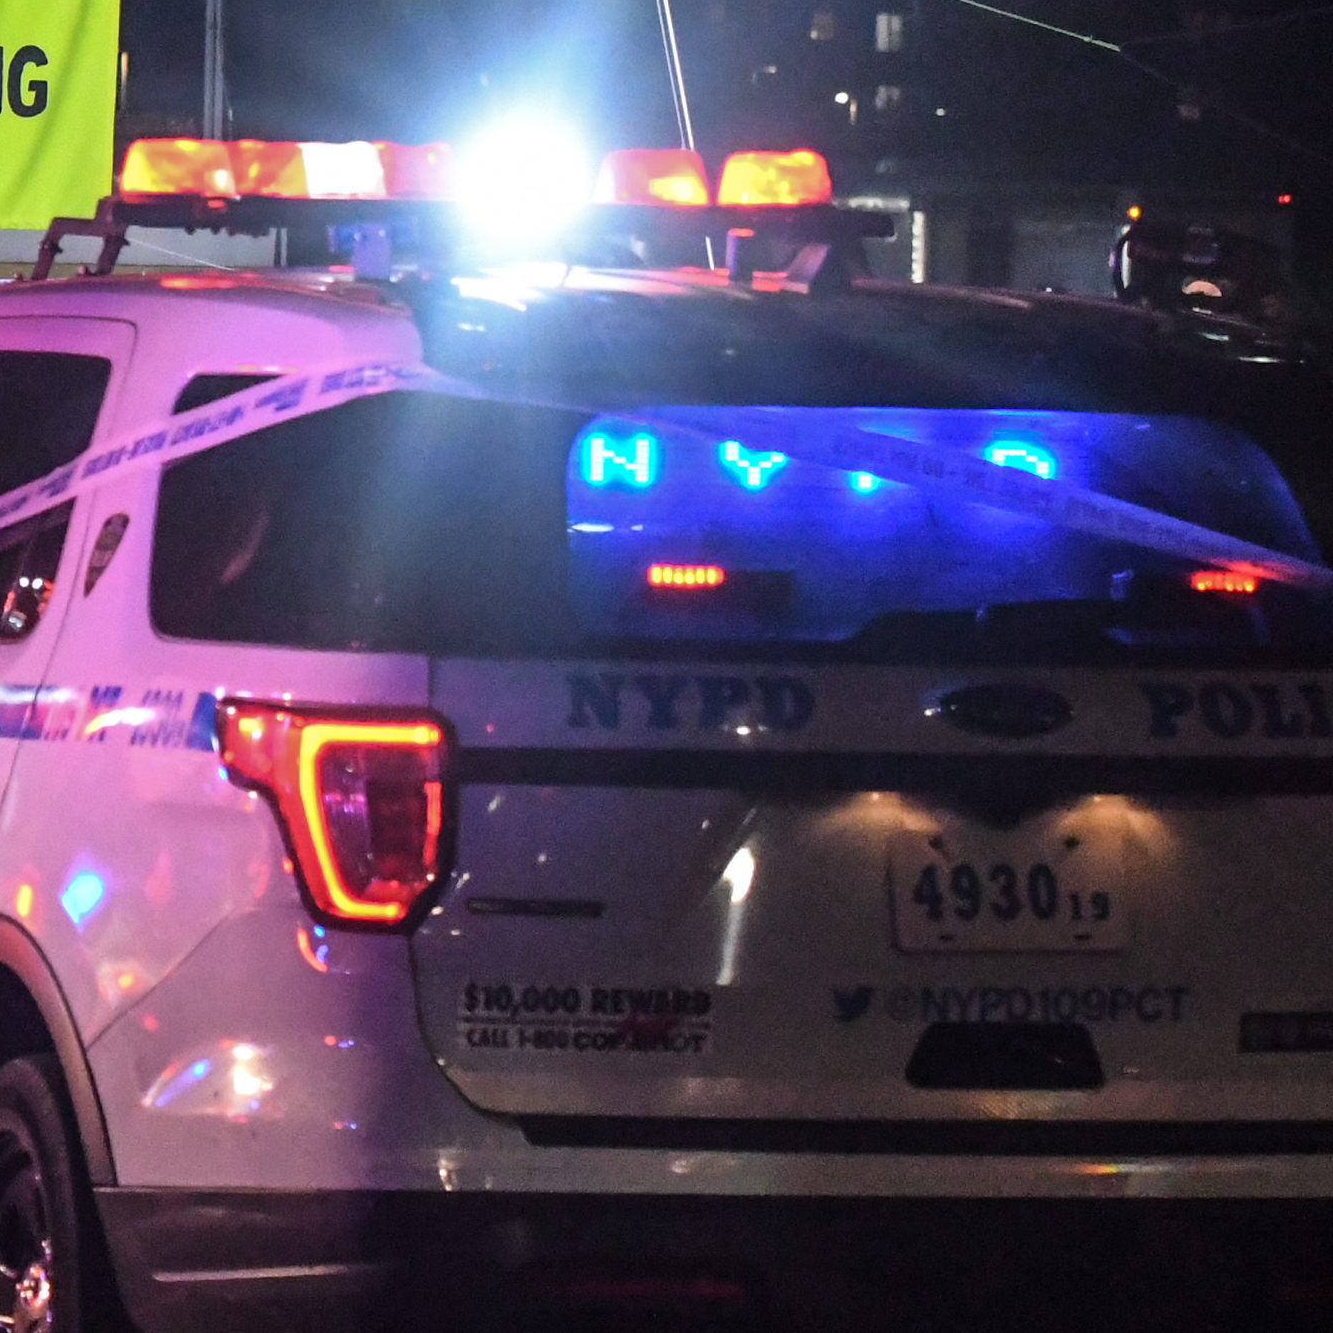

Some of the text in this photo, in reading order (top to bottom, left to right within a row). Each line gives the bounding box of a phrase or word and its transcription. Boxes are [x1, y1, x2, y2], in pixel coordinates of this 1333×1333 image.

[566, 674, 816, 730] NYPD
[911, 863, 1111, 921] 4930 19
[463, 982, 712, 1017] $10,000 REWARD
[466, 1027, 509, 1048] CALL
